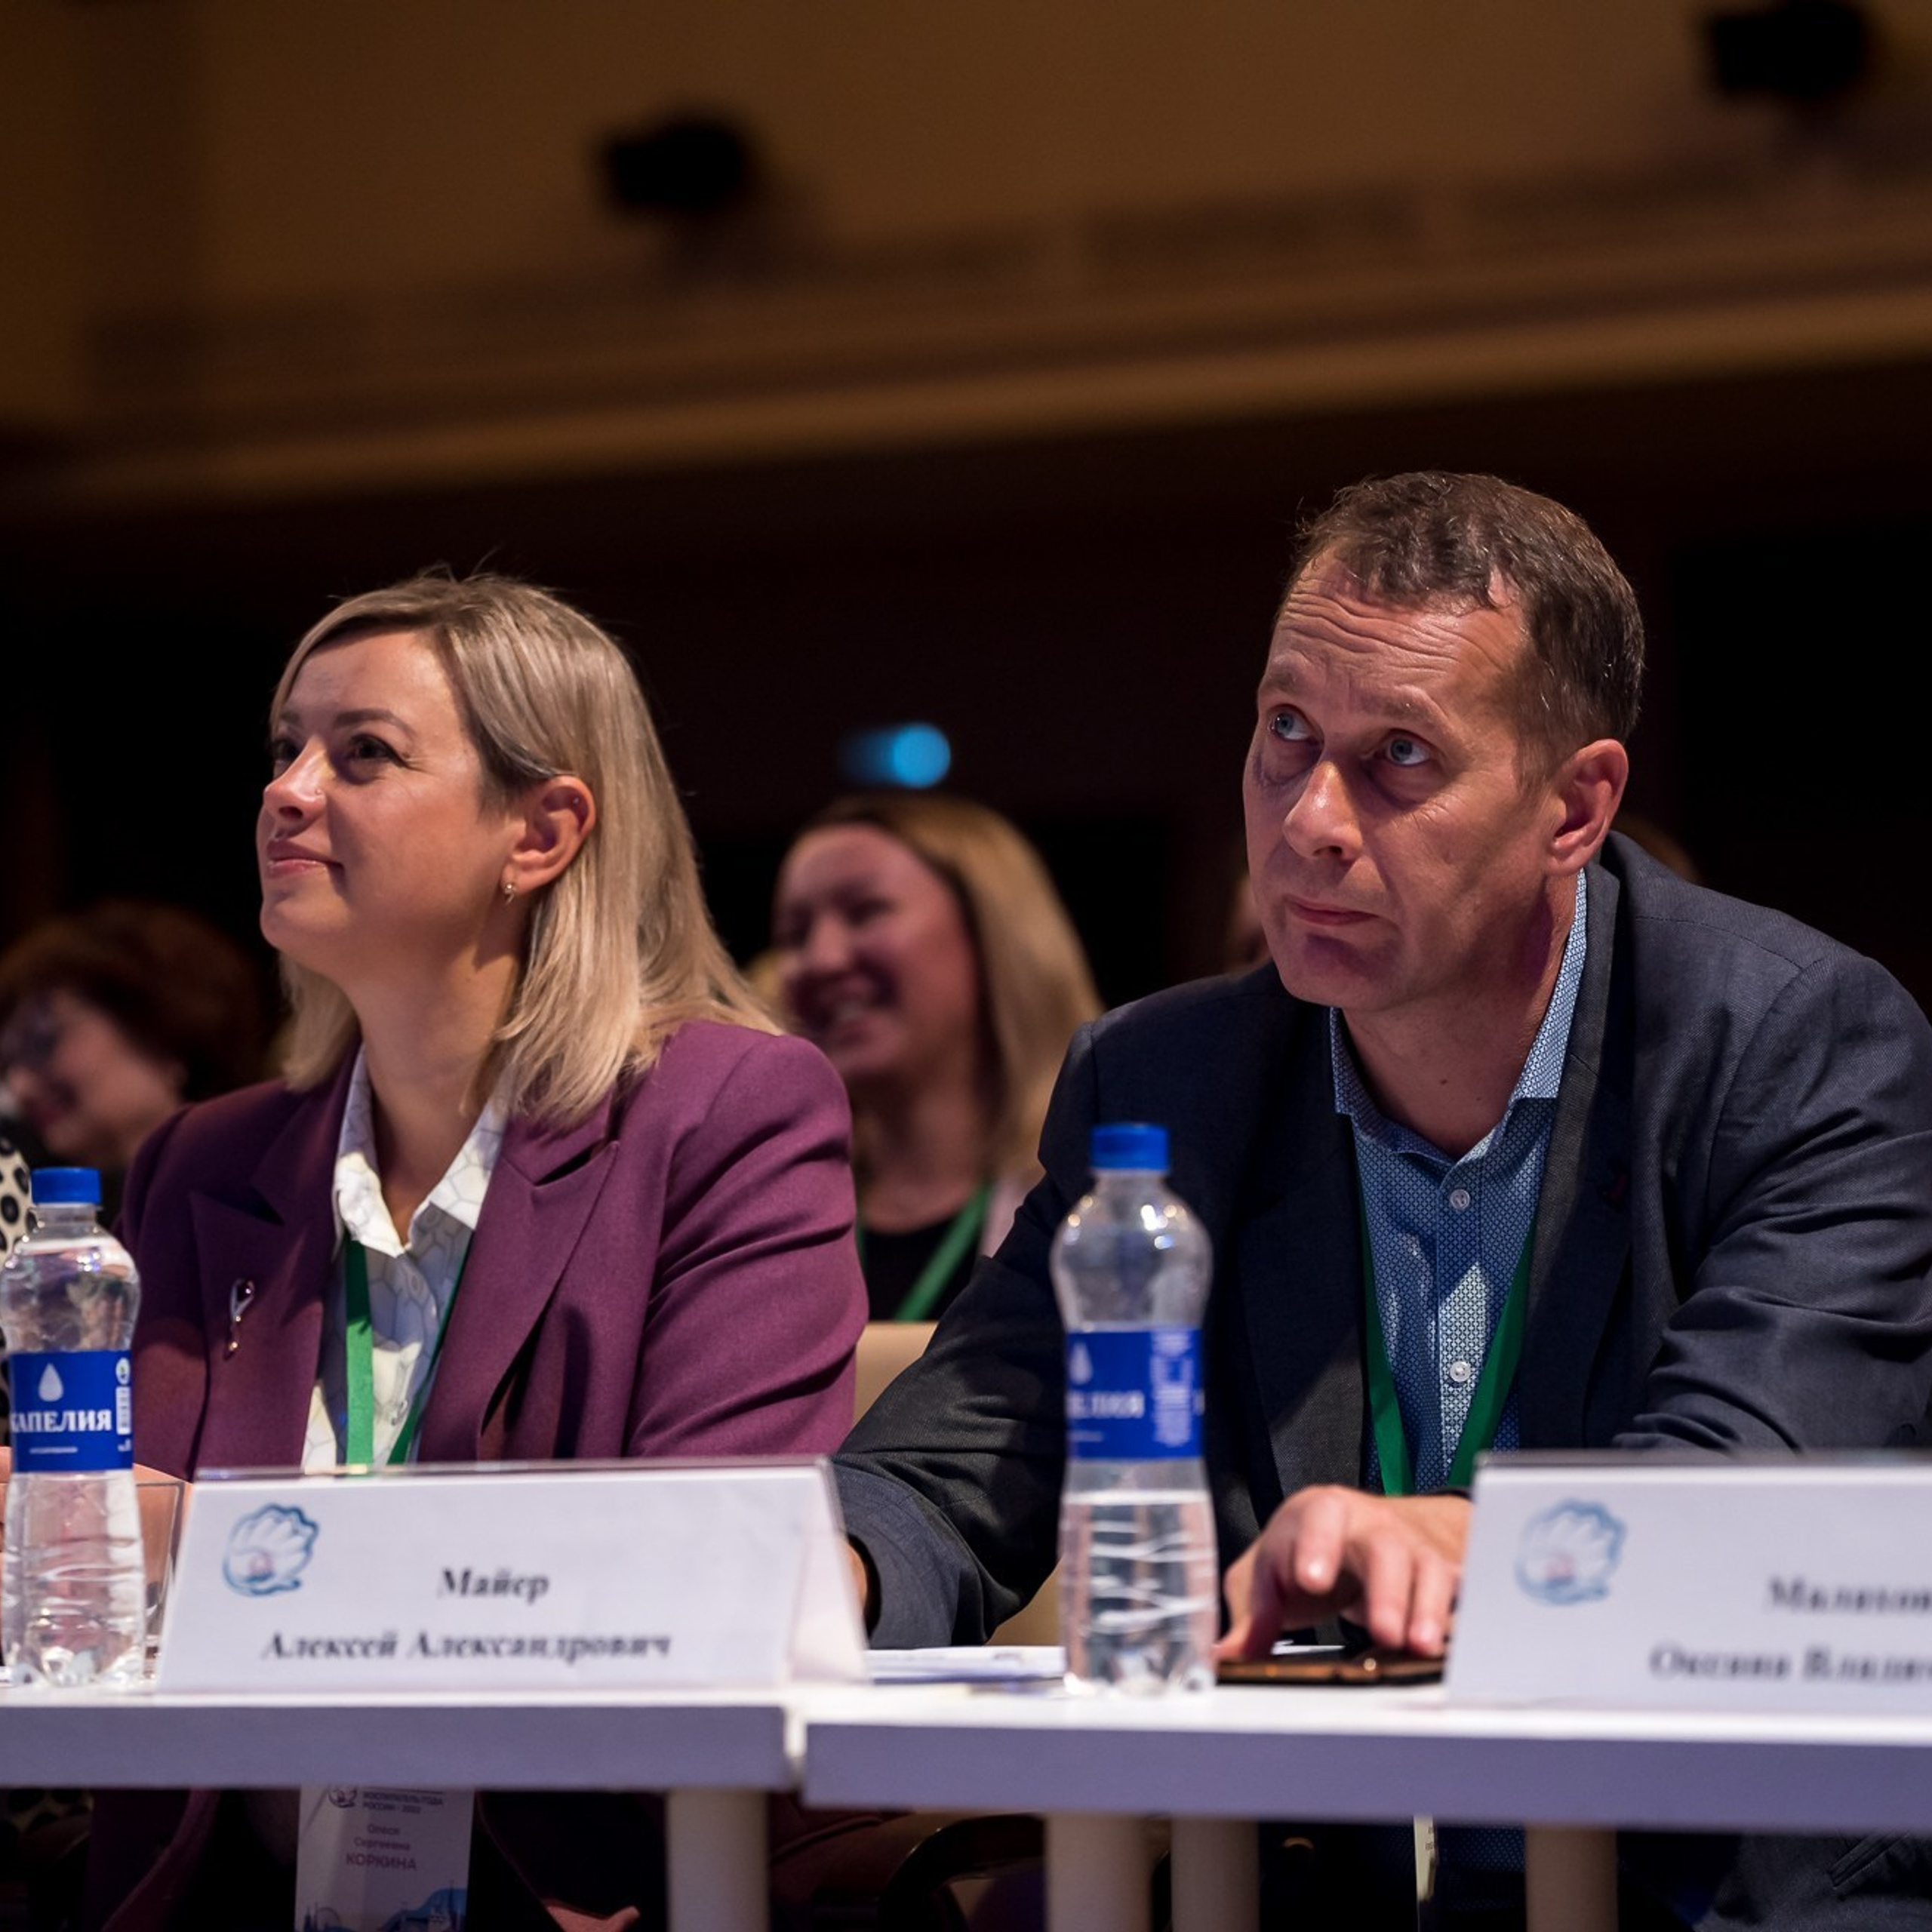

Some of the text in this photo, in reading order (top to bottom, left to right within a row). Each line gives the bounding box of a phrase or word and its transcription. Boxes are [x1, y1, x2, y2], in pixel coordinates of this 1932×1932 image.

[436, 1567, 550, 1605] Майер
[261, 1628, 672, 1666] Алексей Александрович
[346, 1854, 417, 1869] КОРКИНА
